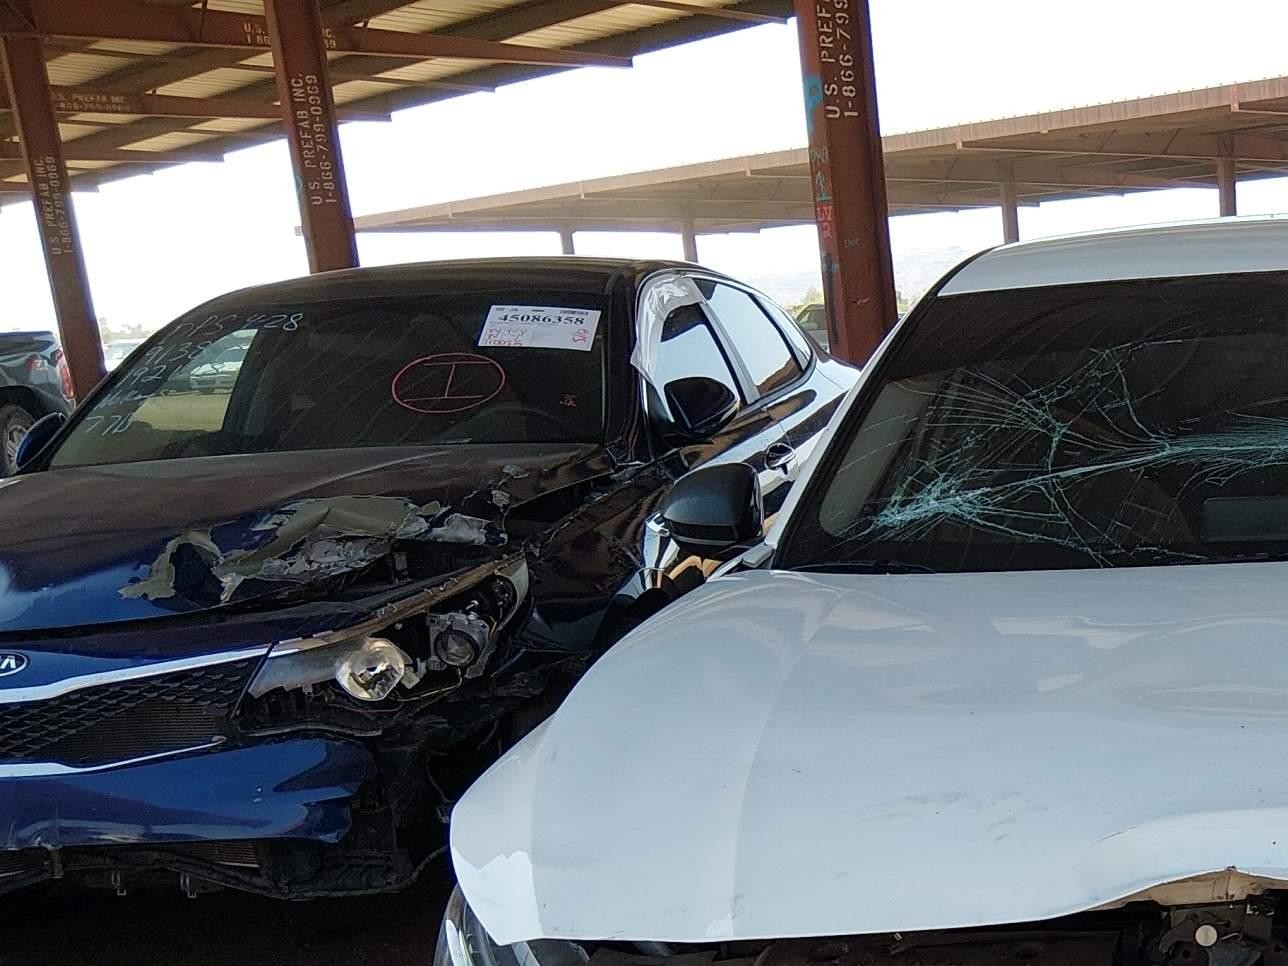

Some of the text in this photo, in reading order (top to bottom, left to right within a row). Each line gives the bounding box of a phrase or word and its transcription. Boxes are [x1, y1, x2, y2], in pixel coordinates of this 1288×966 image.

[291, 73, 305, 102] INC.
[817, 0, 841, 119] U.S. PREF
[296, 110, 317, 168] PREFAB
[305, 74, 337, 203] 1-866-799-0969
[498, 314, 585, 325] 45086358
